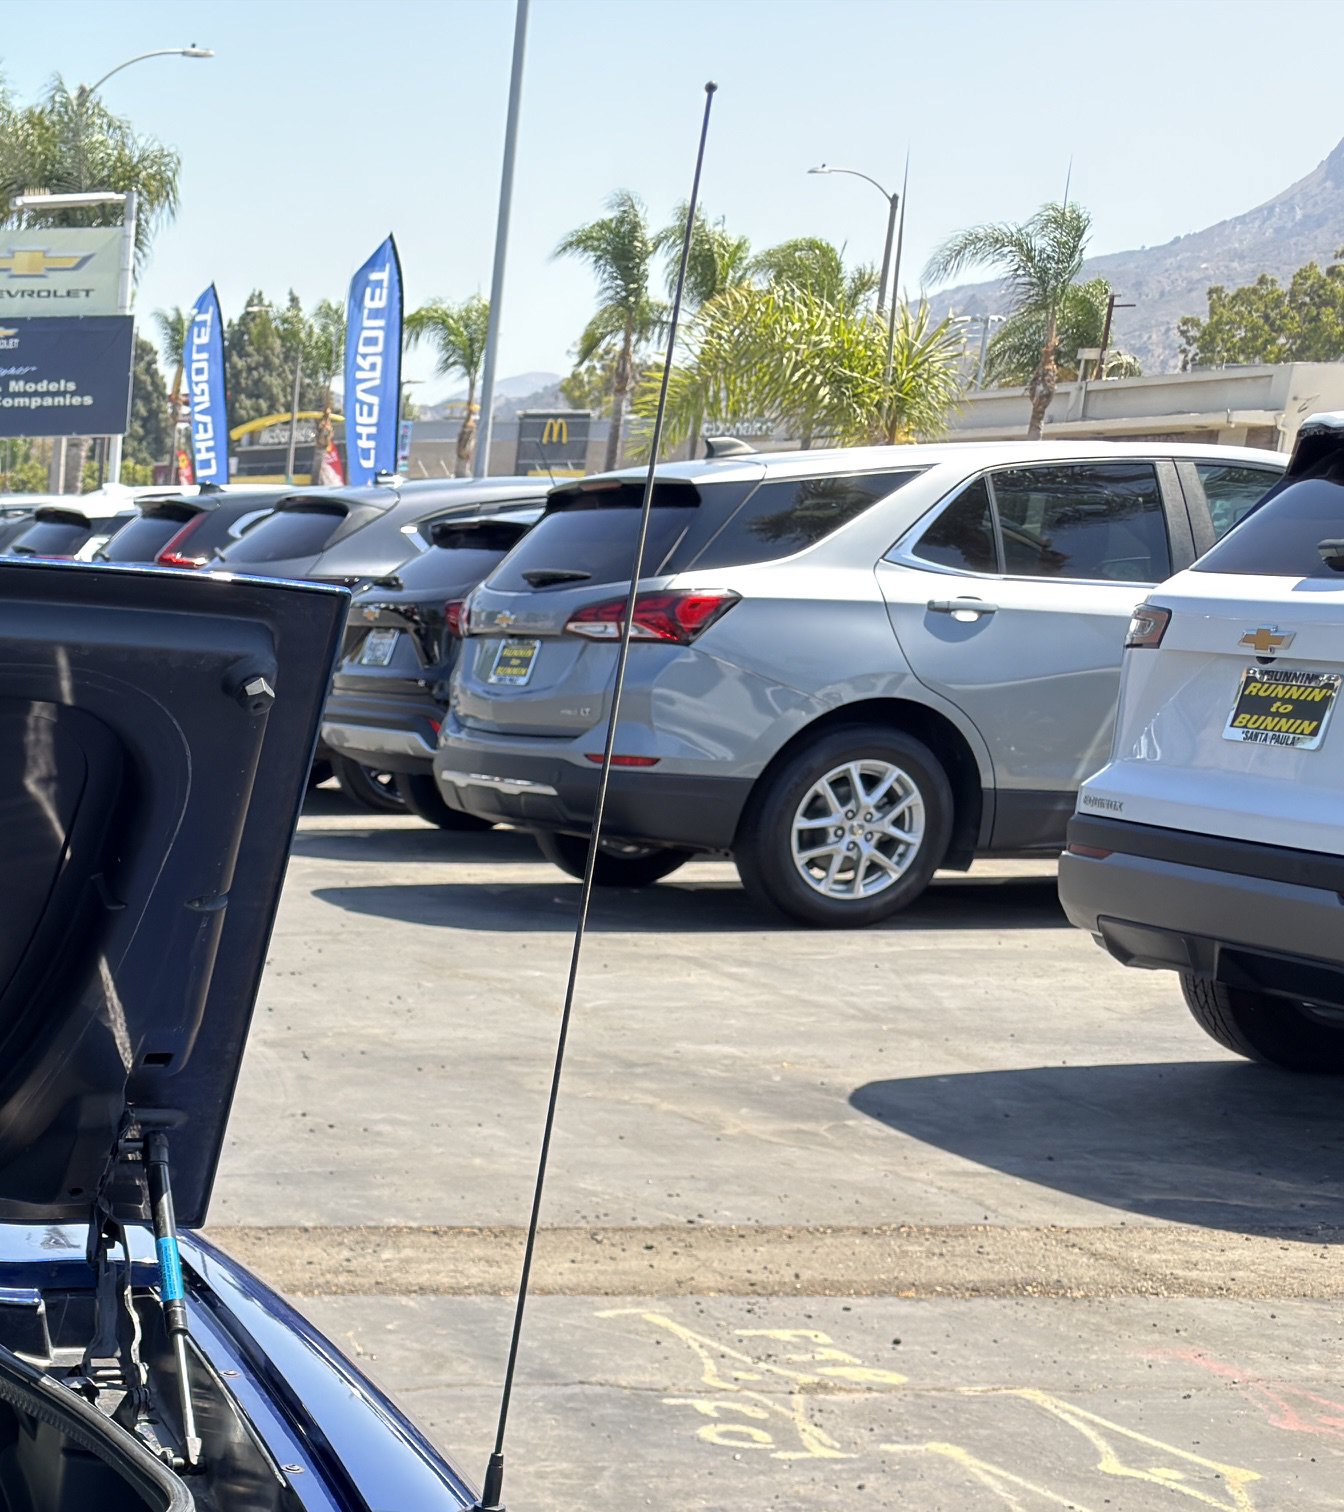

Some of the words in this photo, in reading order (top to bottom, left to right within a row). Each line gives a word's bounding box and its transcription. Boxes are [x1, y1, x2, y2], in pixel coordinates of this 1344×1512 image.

[8, 378, 77, 393] Models
[1244, 682, 1332, 702] RUNNIN'
[1270, 701, 1293, 714] to
[1233, 714, 1319, 735] BUNNIN
[1243, 731, 1269, 744] SANTA
[1270, 733, 1296, 747] PAULA
